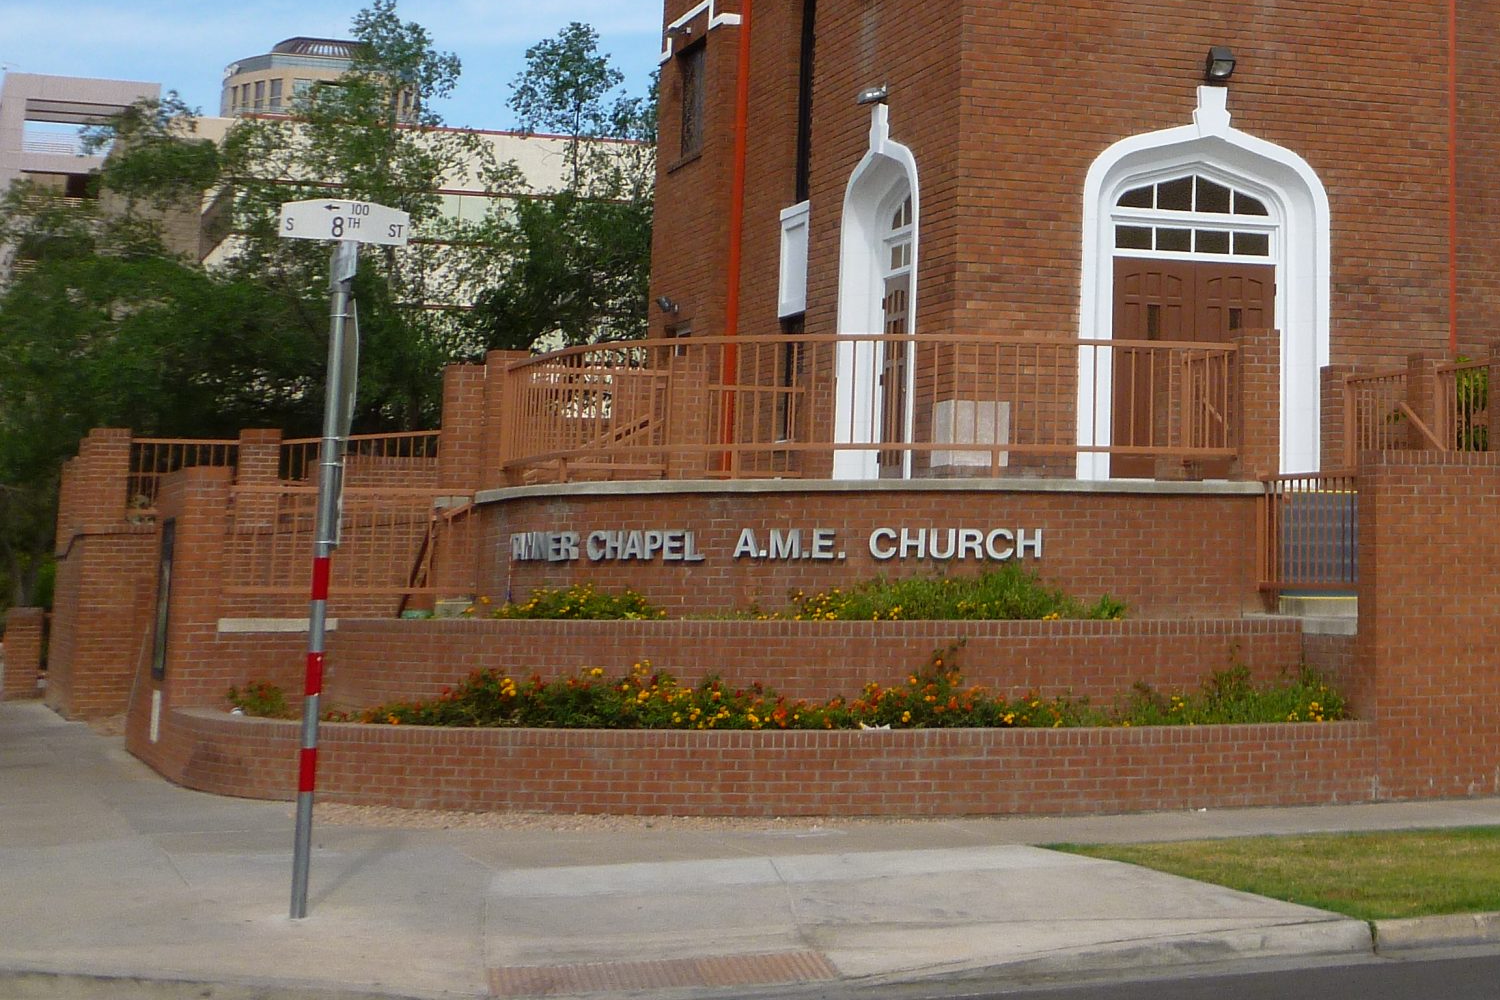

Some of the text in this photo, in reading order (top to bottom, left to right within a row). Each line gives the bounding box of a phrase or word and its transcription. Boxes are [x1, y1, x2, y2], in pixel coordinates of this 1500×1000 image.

[351, 204, 369, 216] 100
[285, 216, 404, 238] S 8TH ST
[586, 530, 706, 561] CHAPEL
[732, 527, 846, 560] A.M.E.
[868, 527, 1043, 560] CHURCH
